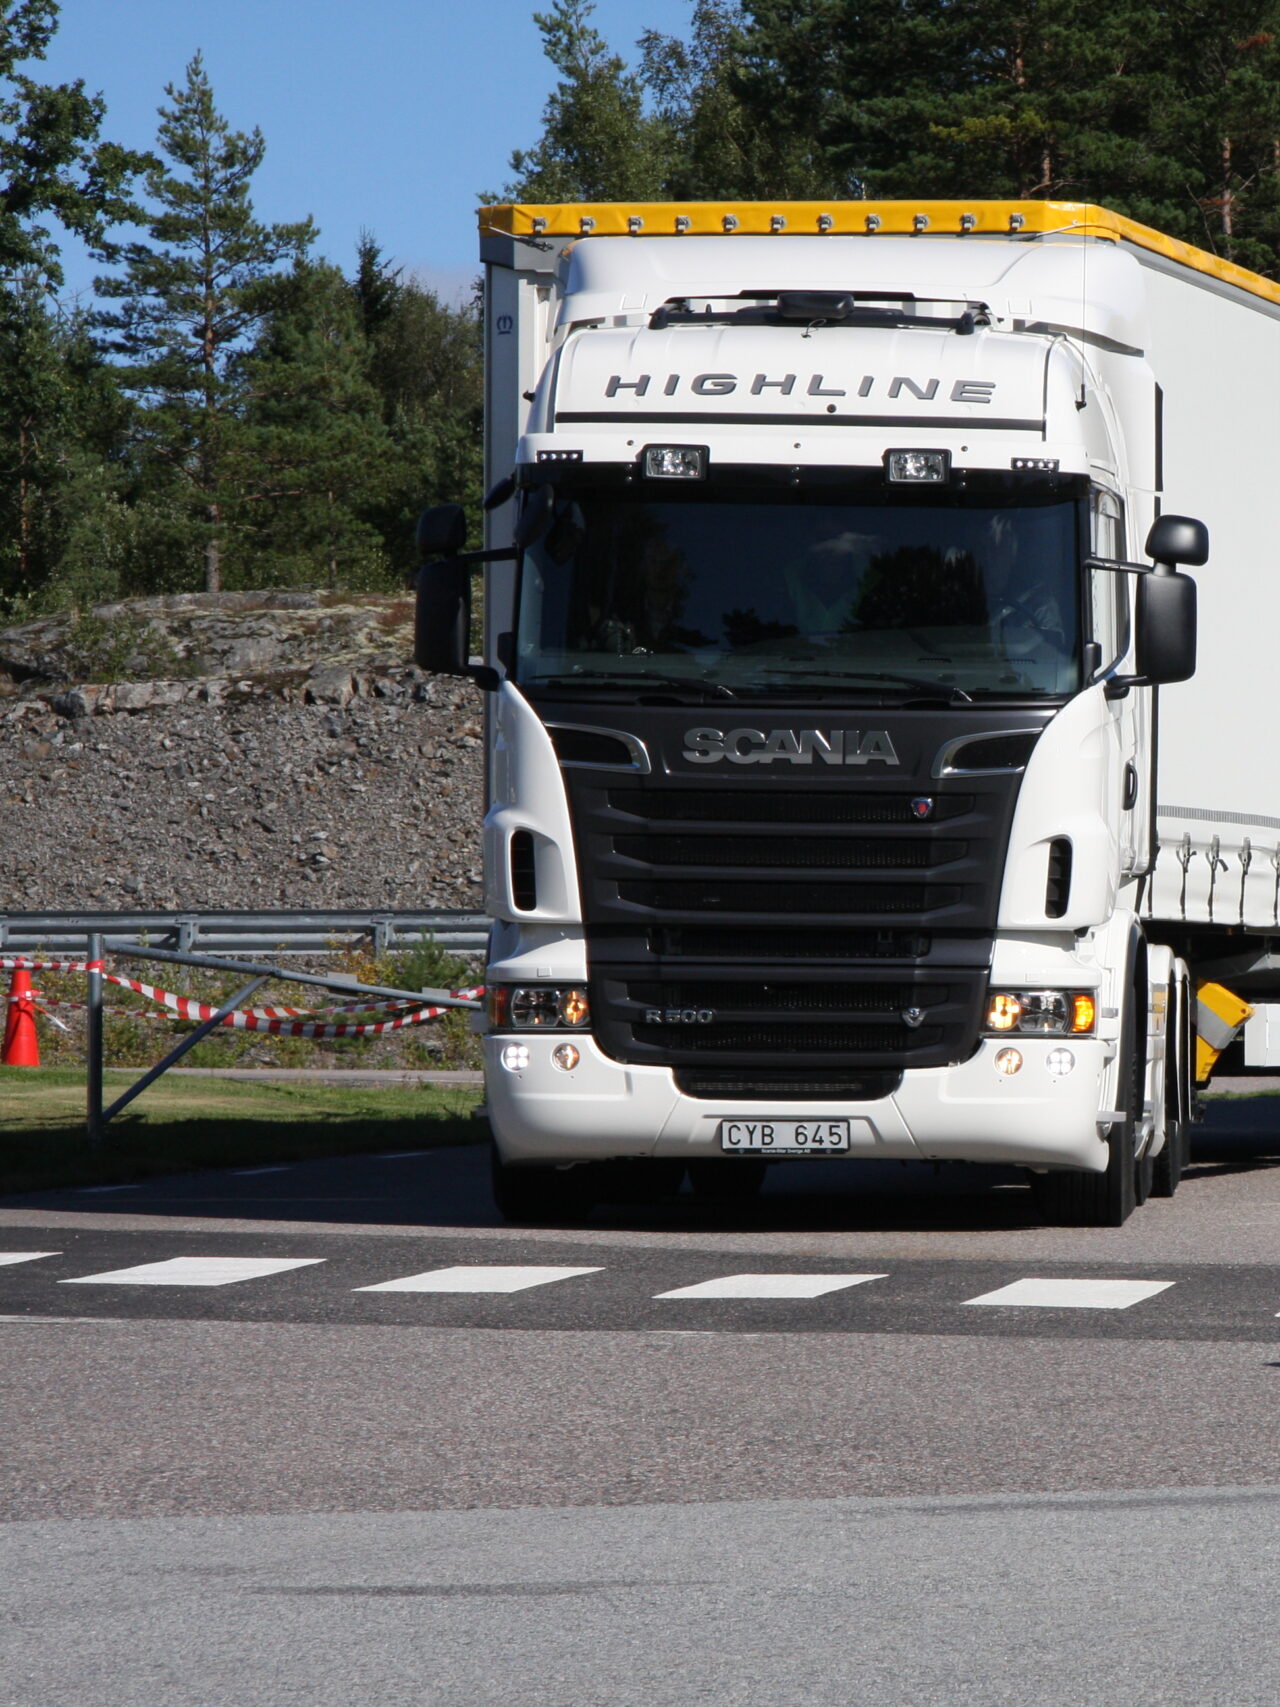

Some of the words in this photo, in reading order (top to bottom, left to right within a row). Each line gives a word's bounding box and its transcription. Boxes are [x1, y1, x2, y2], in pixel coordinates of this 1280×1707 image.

[604, 373, 996, 404] HIGHLINE
[681, 727, 900, 765] SCANIA
[645, 1009, 662, 1024] R
[728, 1124, 774, 1145] CYB
[795, 1124, 842, 1145] 645
